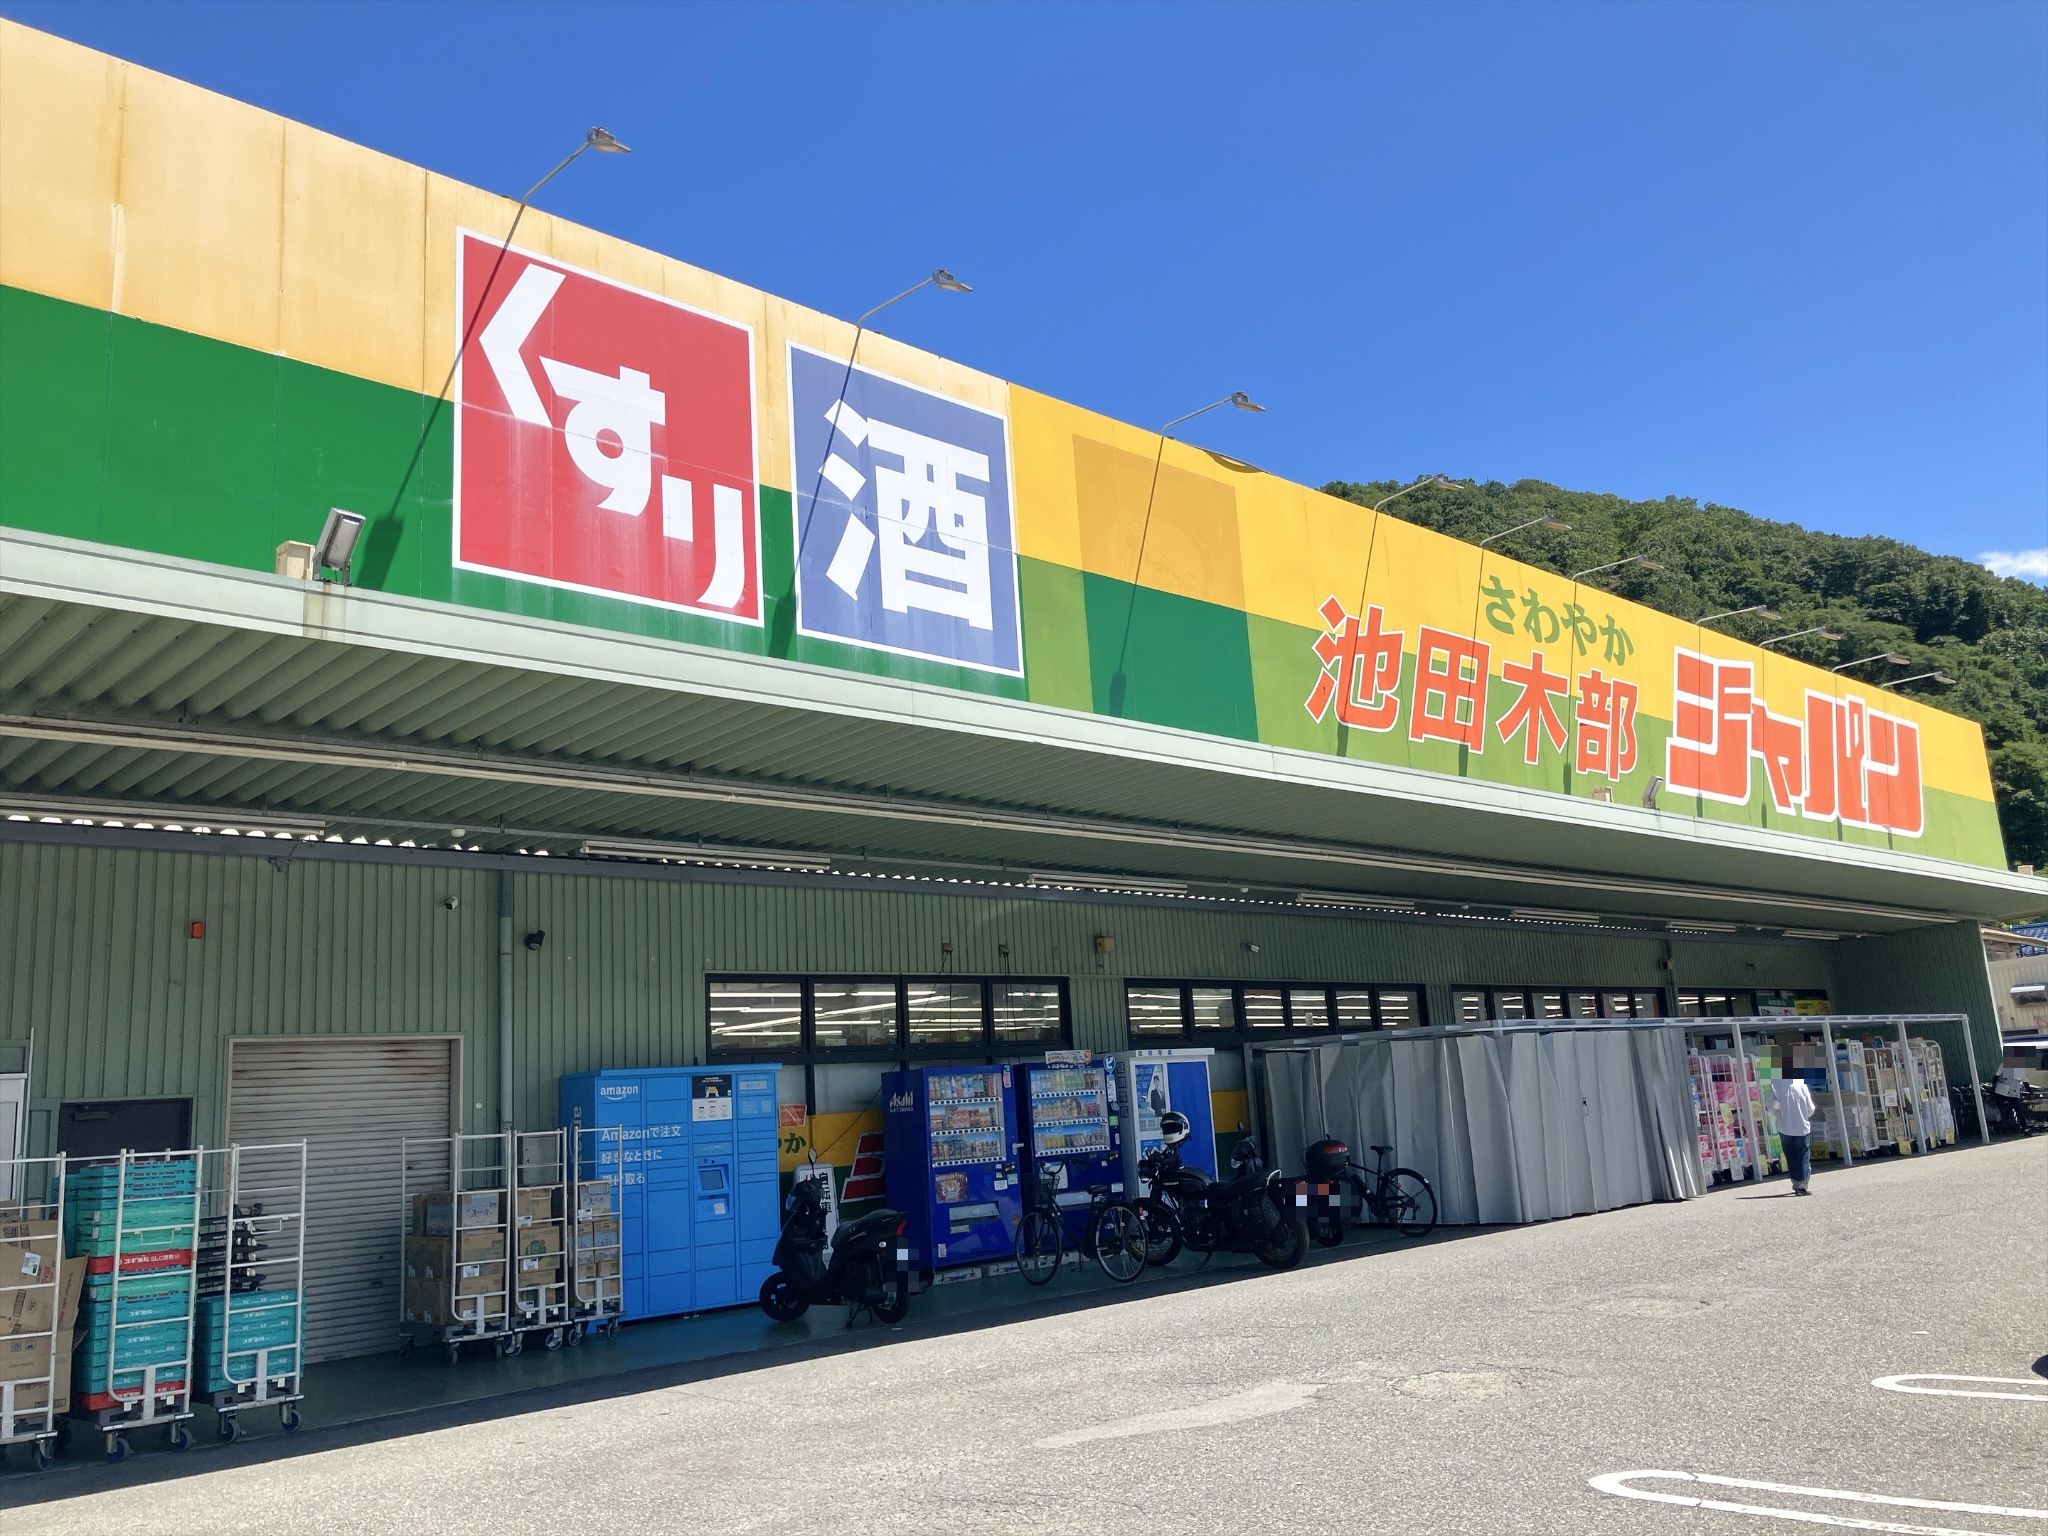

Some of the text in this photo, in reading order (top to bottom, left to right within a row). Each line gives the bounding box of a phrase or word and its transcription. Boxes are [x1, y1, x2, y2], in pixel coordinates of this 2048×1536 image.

[478, 263, 746, 609] くすり
[817, 398, 994, 632] 酒
[1305, 595, 1639, 783] 池田木部
[1481, 573, 1635, 666] さわやか
[1666, 646, 1925, 839] ジャパン
[600, 1085, 639, 1096] amazon
[601, 1125, 681, 1142] Amazonで注文
[889, 1091, 914, 1108] Asahi
